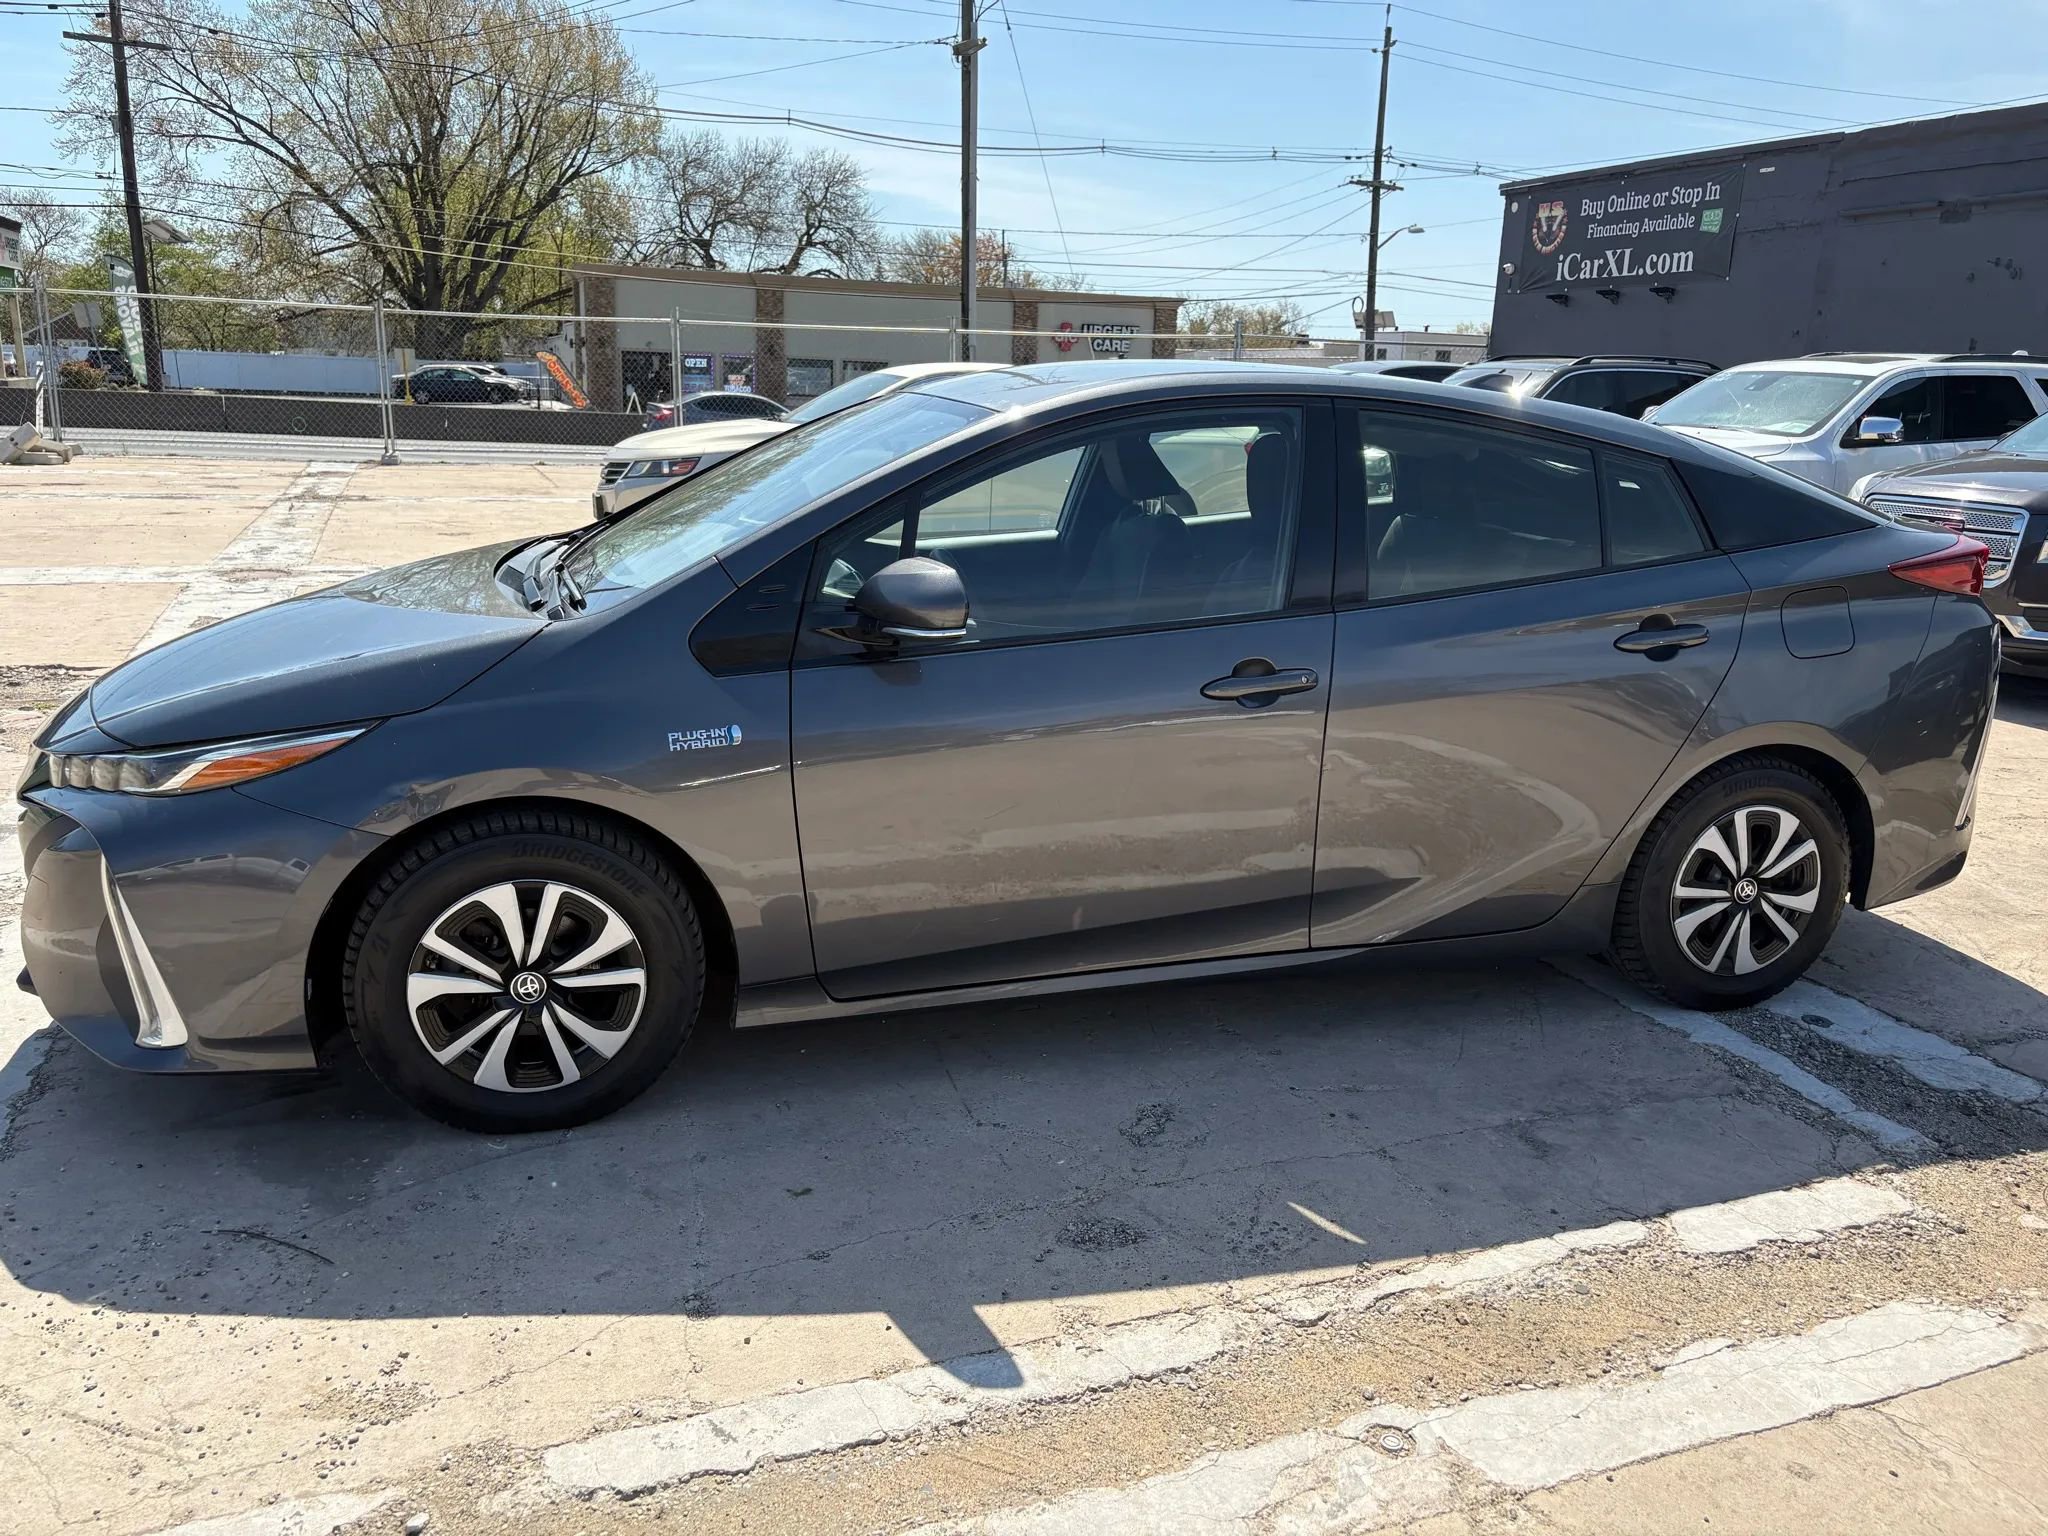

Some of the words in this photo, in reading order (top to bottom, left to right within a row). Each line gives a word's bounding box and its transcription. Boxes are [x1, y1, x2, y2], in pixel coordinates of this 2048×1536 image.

[1580, 199, 1605, 219] Buy
[1607, 191, 1650, 213] Online
[1652, 191, 1669, 208] or
[1670, 186, 1702, 207] Stop
[1704, 181, 1721, 201] In
[1587, 219, 1640, 239] Financing
[1641, 212, 1696, 233] Available
[1556, 247, 1694, 282] iCarXL.com
[1092, 338, 1130, 352] CARE
[684, 358, 708, 368] OPEN
[723, 384, 752, 393] TOBACCO
[668, 727, 727, 741] PLUG-IN
[669, 737, 728, 752] HYBRID
